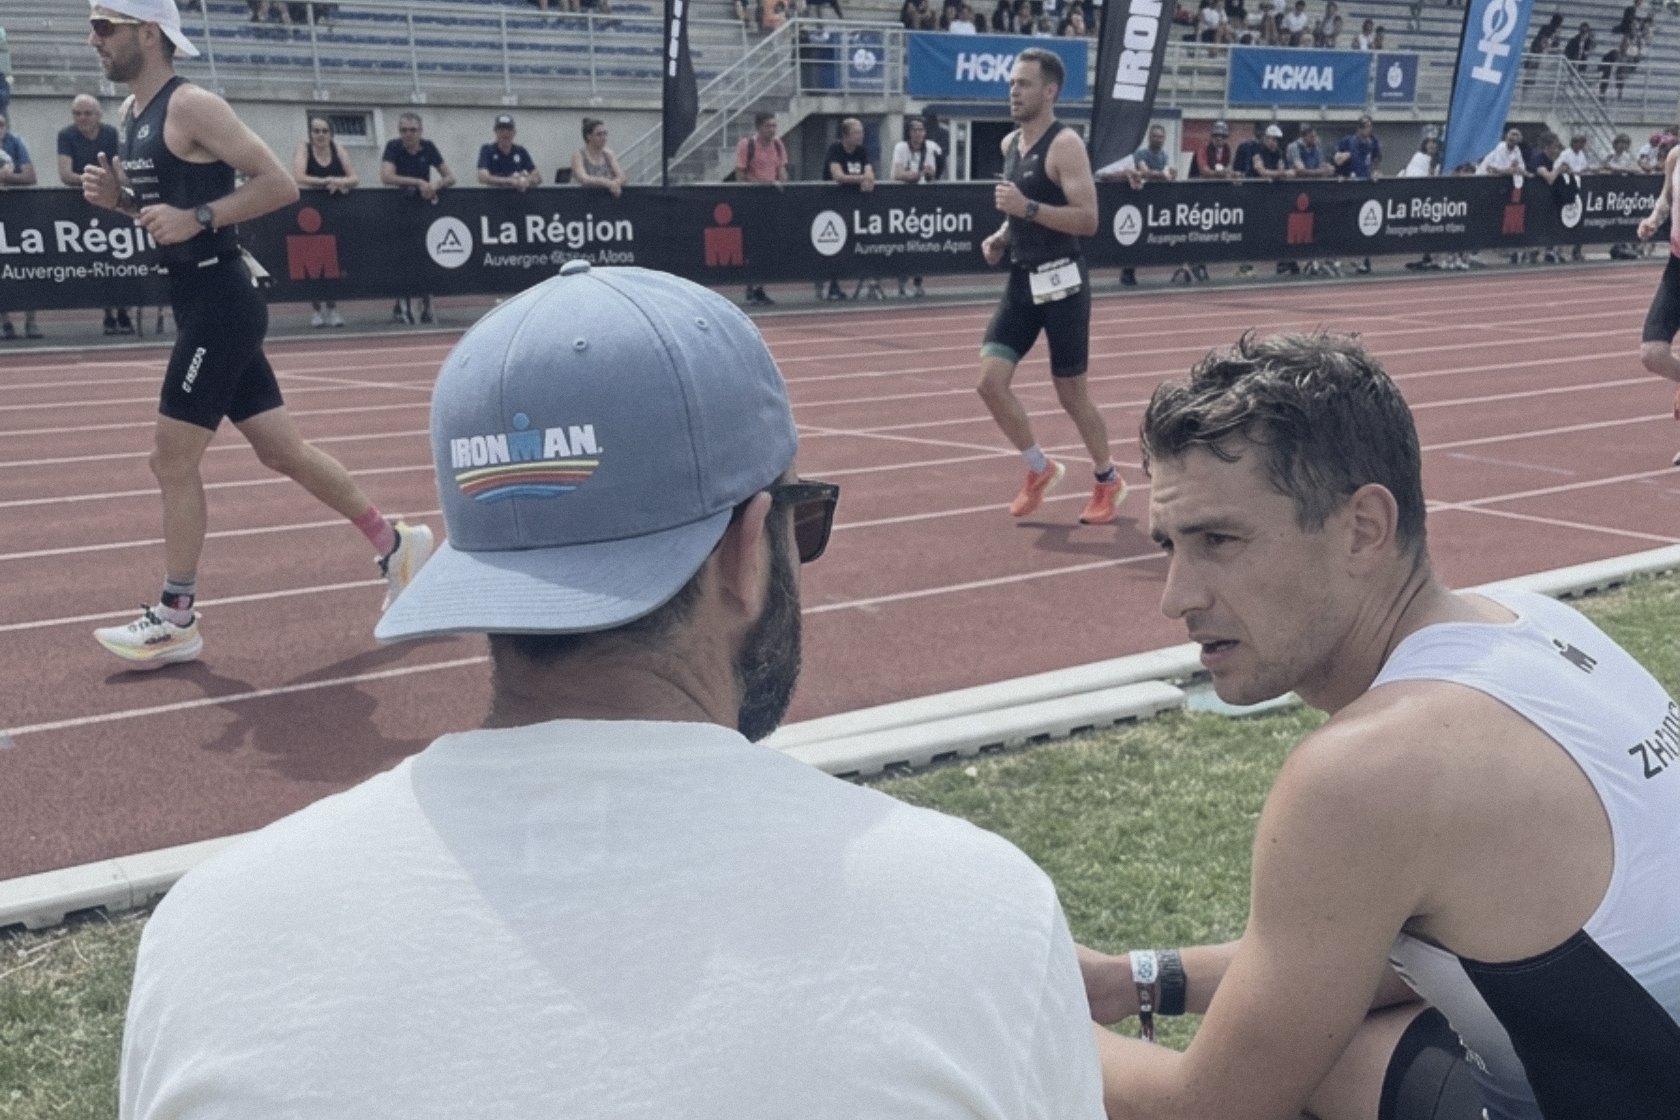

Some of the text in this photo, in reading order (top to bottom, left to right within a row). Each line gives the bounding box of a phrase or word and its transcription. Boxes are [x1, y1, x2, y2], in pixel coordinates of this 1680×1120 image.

[854, 207, 972, 239] La Région
[1147, 202, 1244, 230] La Région
[1387, 197, 1467, 222] La Région
[0, 218, 156, 259] La Régi
[480, 213, 633, 249] La Région
[451, 413, 598, 468] IRONMAN
